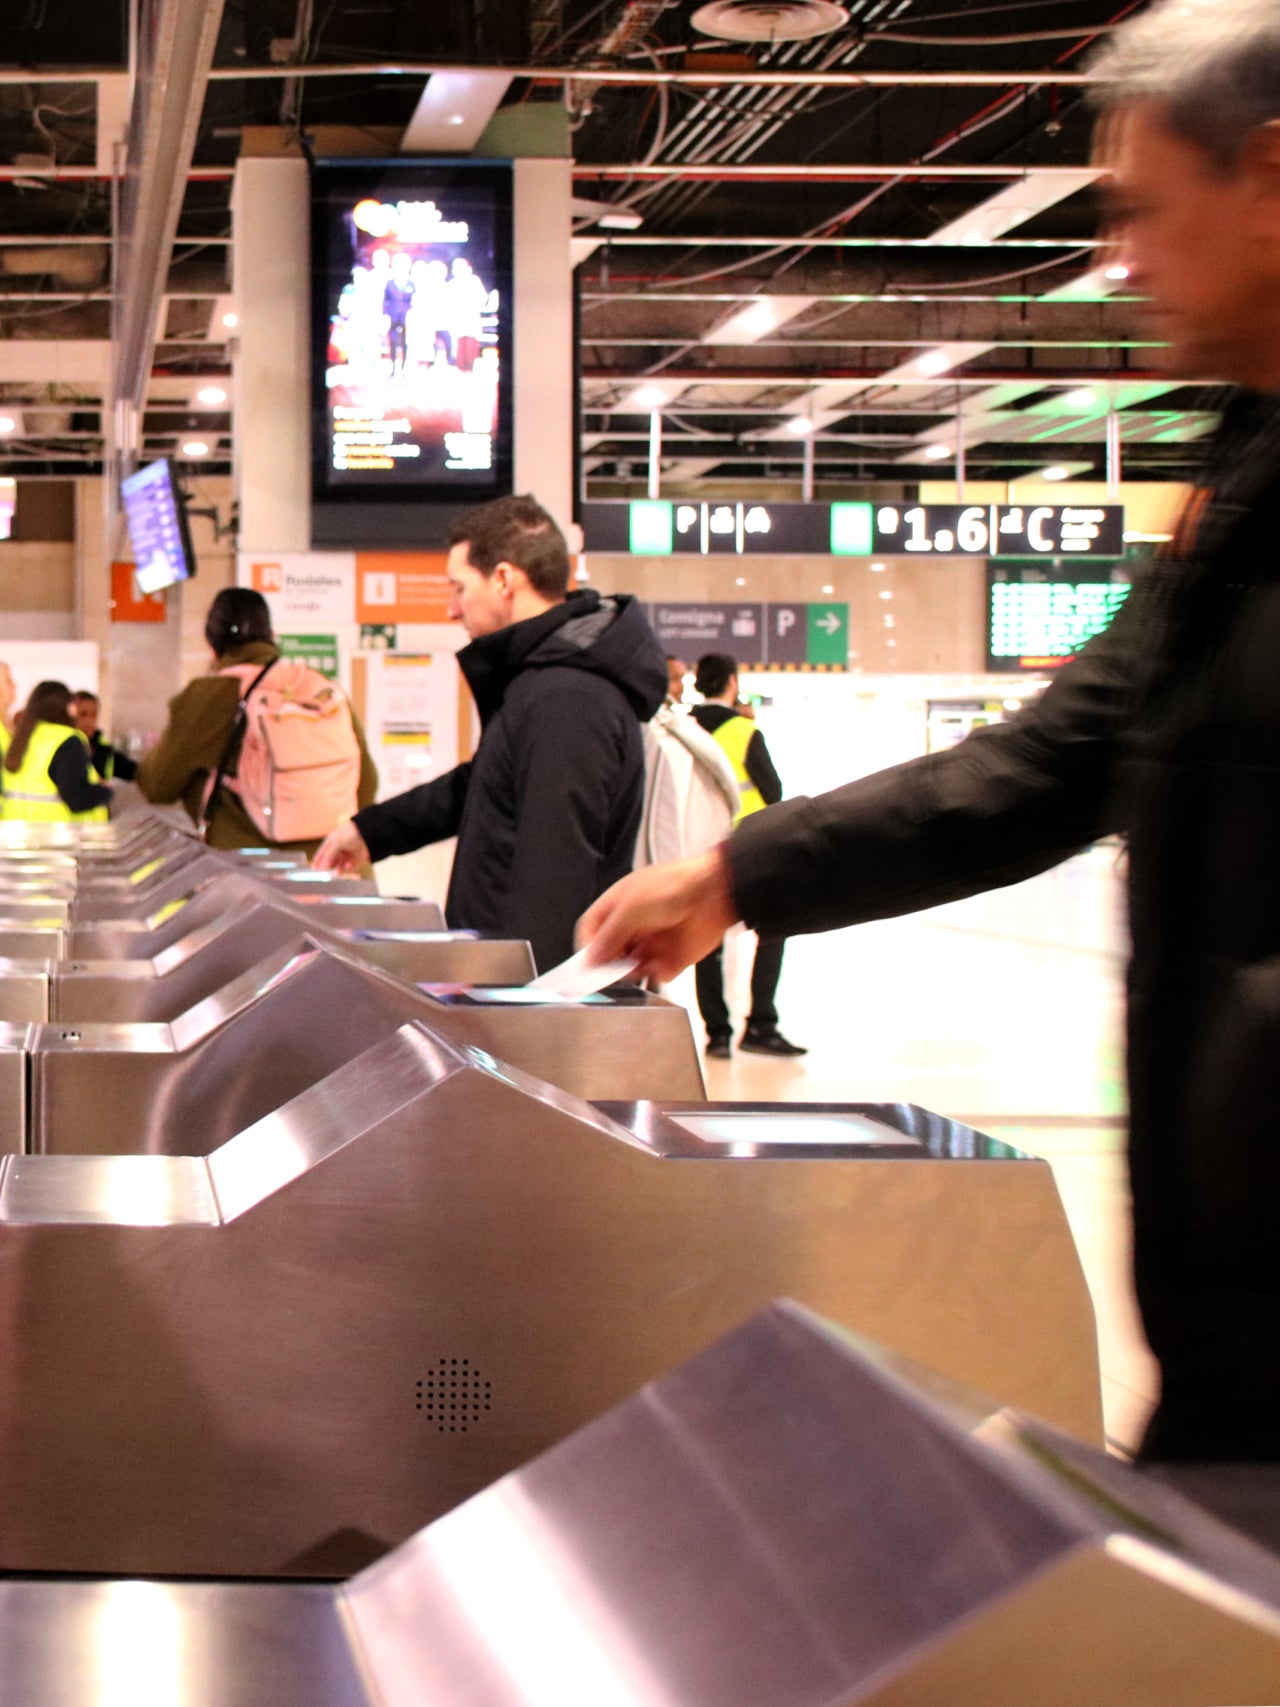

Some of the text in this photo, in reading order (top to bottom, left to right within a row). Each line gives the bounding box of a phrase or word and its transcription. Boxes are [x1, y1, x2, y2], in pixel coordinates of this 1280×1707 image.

[677, 506, 697, 533] P
[1027, 507, 1054, 551] C
[777, 609, 796, 636] P
